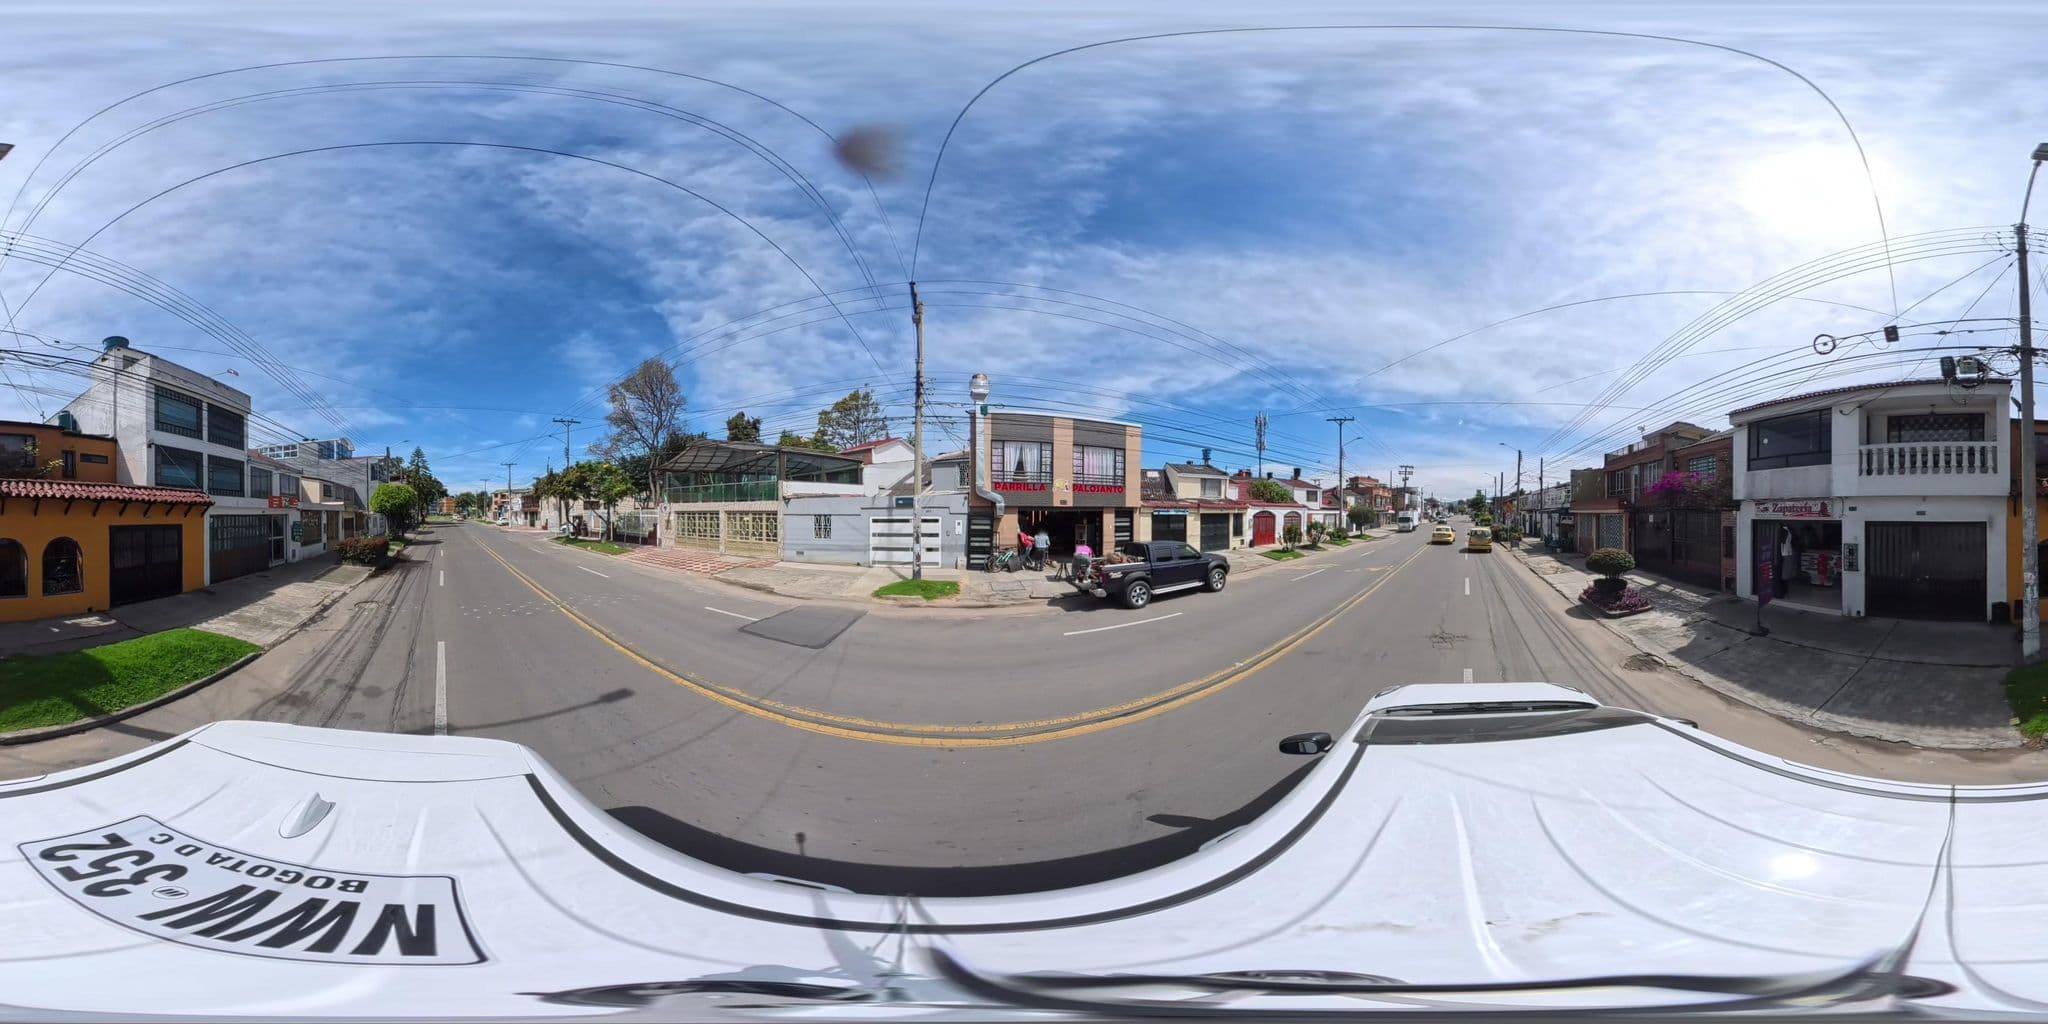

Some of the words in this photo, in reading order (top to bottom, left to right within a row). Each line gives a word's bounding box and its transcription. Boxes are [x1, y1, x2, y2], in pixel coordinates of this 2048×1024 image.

[994, 482, 1047, 493] PARRILLA
[39, 832, 188, 898] 352
[205, 851, 369, 894] BOGOTA
[137, 884, 437, 956] NWW
